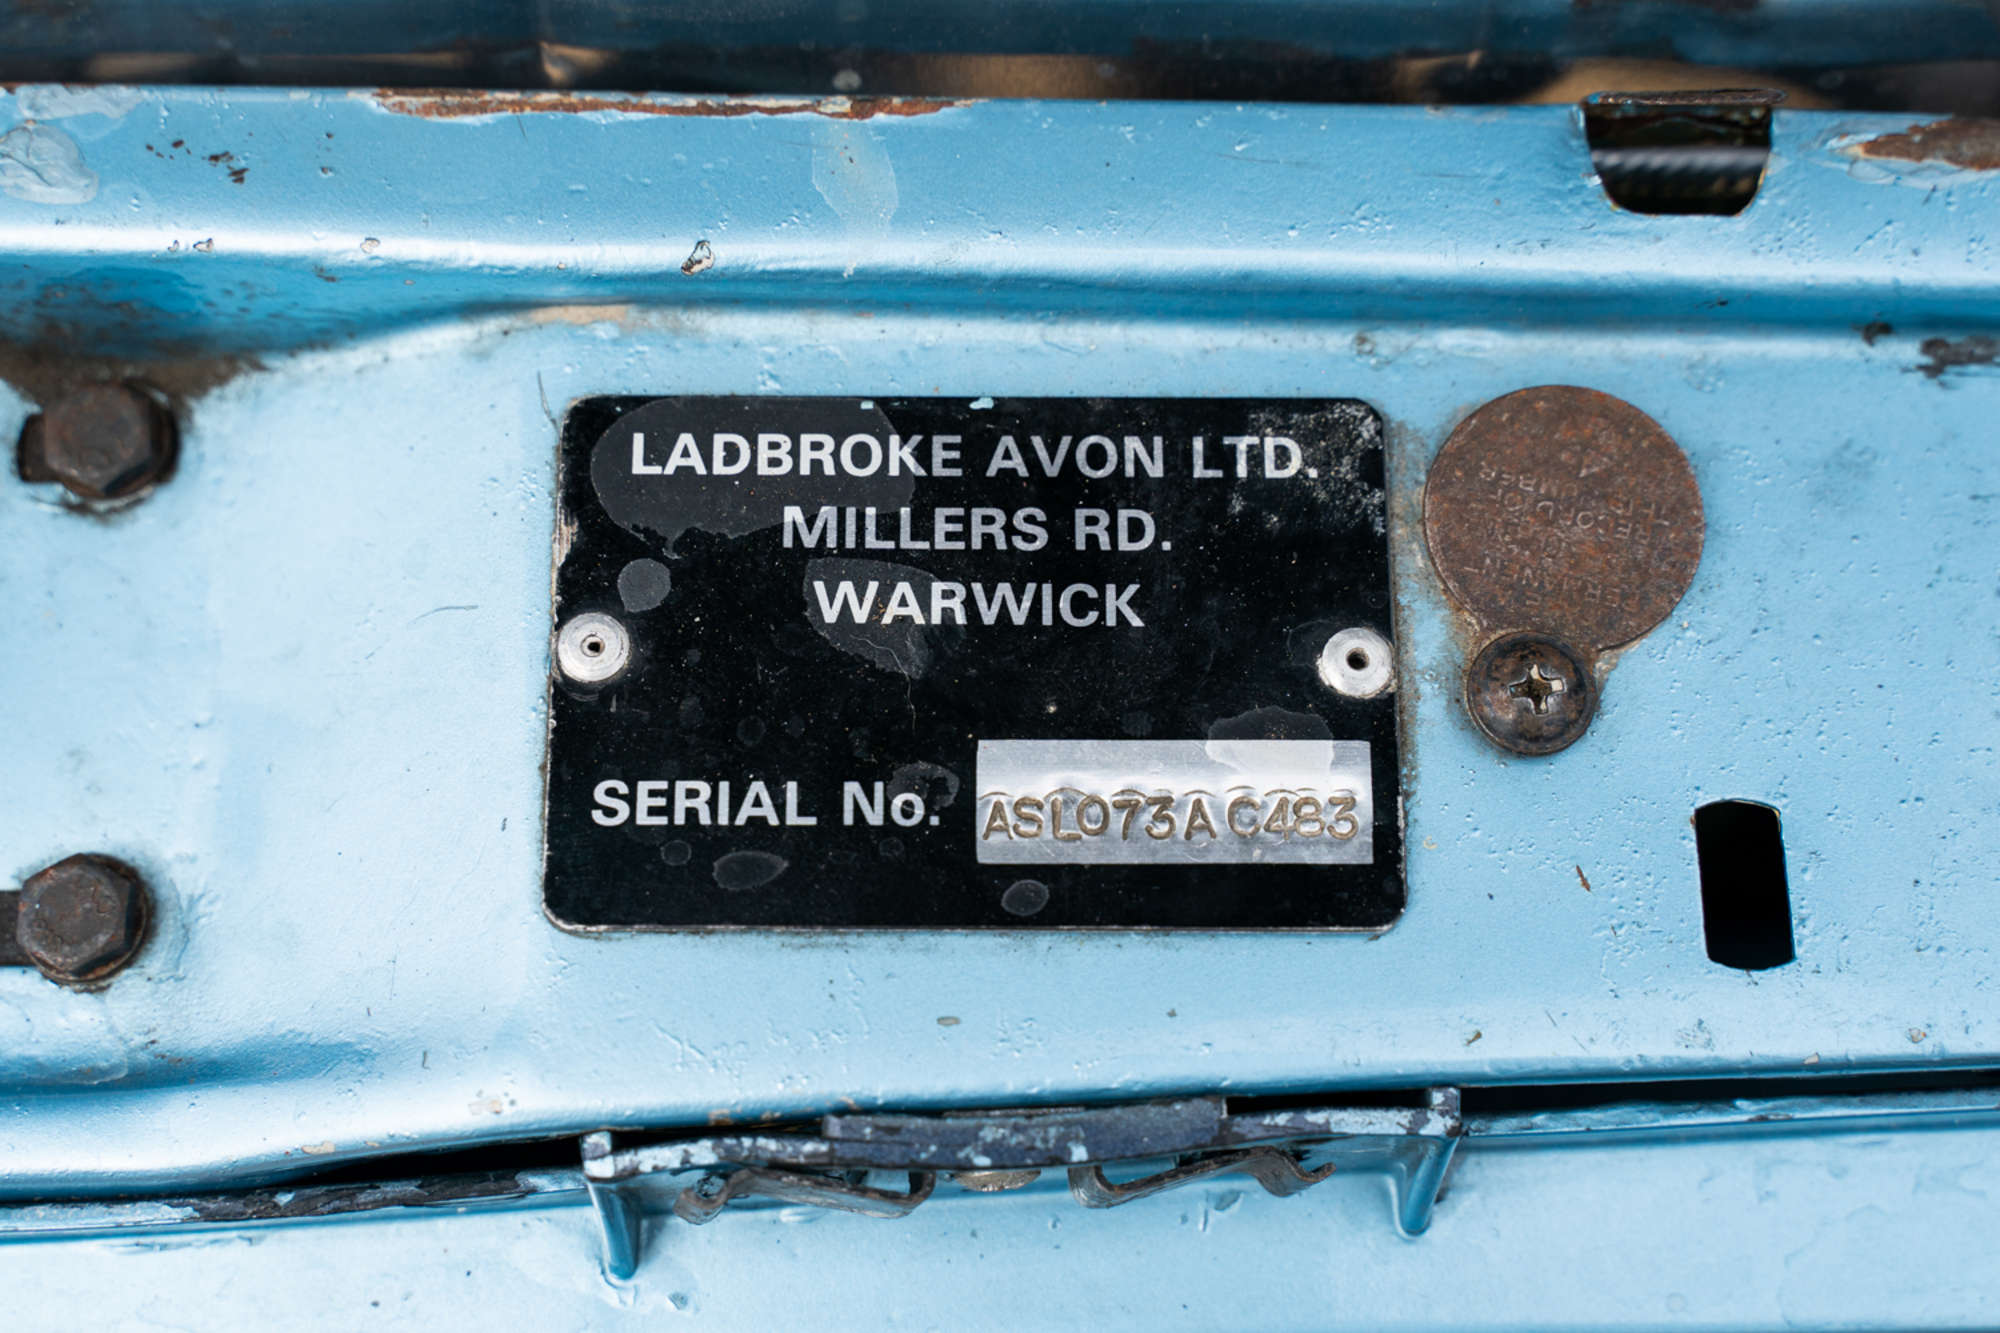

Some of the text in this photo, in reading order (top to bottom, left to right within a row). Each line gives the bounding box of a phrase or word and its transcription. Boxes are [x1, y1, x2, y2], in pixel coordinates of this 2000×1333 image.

[632, 433, 1318, 478] LADBROKE AVON LTD.
[784, 506, 1171, 551] MILLERS RD.
[813, 581, 1144, 626] WARWICK
[592, 780, 816, 826] SERIAL
[844, 782, 939, 826] No.
